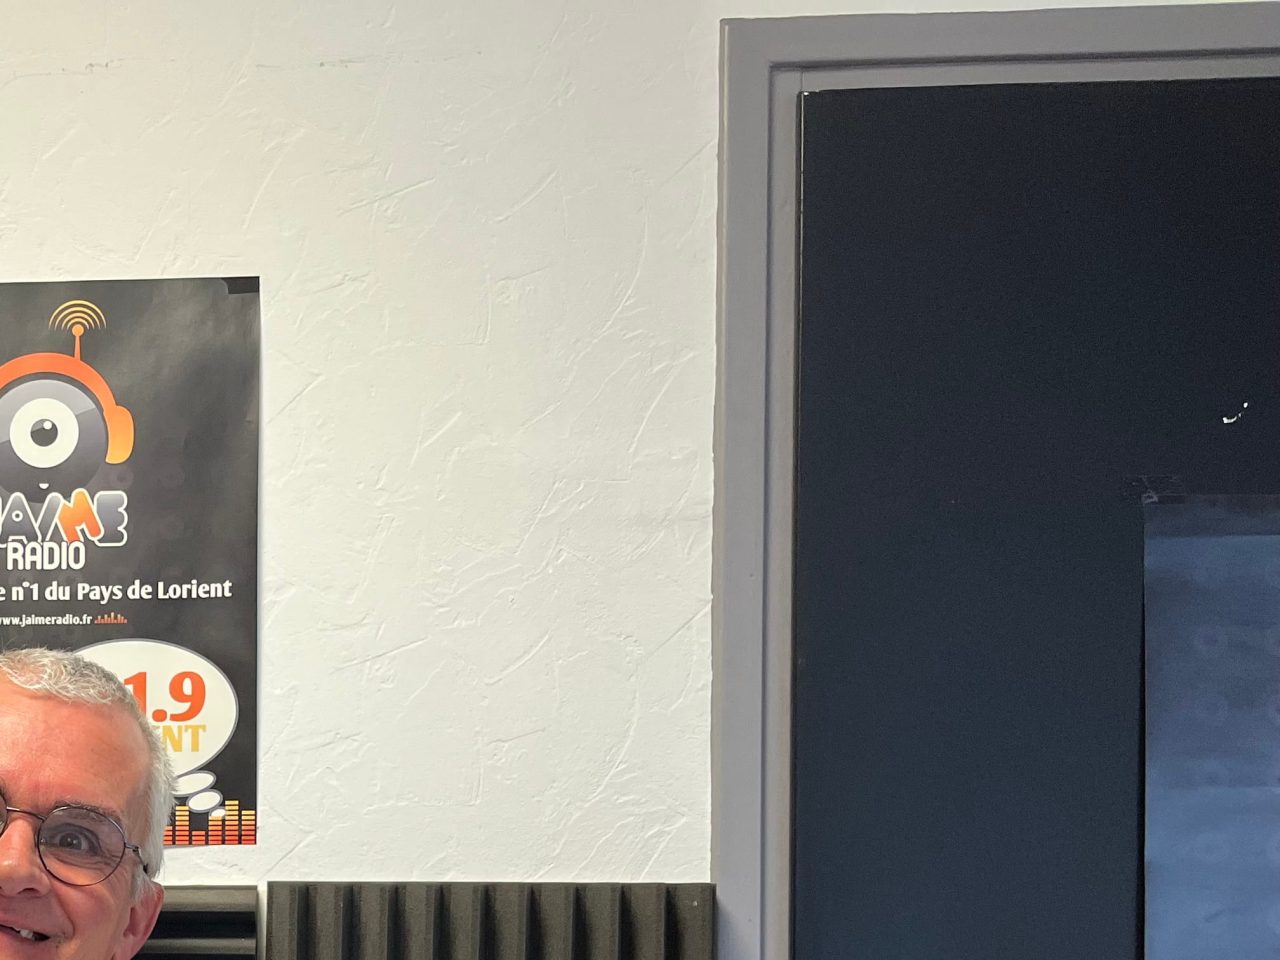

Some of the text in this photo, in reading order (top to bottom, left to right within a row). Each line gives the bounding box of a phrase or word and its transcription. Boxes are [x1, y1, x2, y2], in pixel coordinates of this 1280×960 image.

[7, 541, 86, 570] RADIO
[45, 581, 71, 600] du
[77, 582, 122, 605] Pays
[127, 579, 152, 600] de
[157, 579, 232, 599] Lorient
